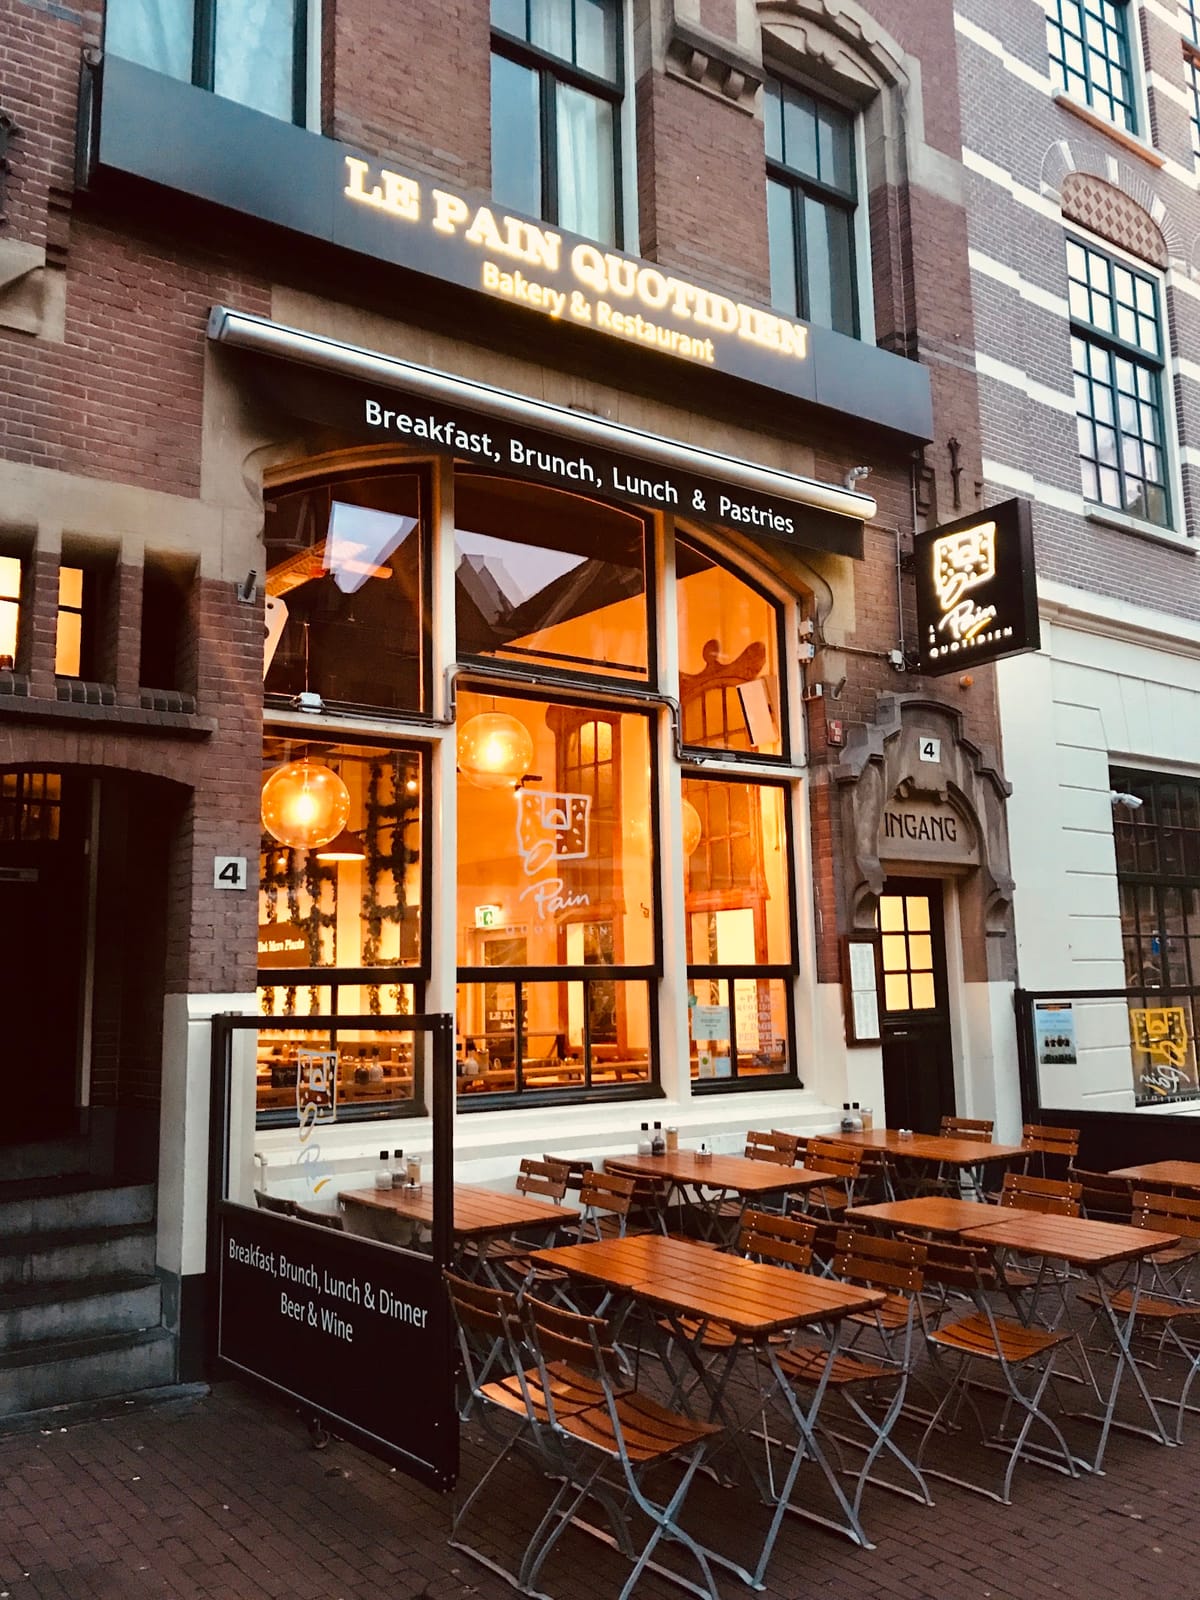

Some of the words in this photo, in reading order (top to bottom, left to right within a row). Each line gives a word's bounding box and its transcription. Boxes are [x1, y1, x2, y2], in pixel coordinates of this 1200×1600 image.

[345, 157, 419, 219] LE
[433, 190, 561, 270] PAIN
[572, 244, 807, 357] QUOTIDIEN
[483, 262, 567, 316] Bakery
[569, 289, 592, 324] &
[598, 304, 714, 363] Restaurant
[365, 399, 502, 464] Breakfast,
[509, 439, 604, 490] Brunch,
[612, 466, 679, 505] Lunch
[691, 488, 707, 512] &
[719, 495, 795, 535] Pastries
[929, 626, 1013, 658] QUOTIDIEN
[923, 742, 935, 758] 4
[884, 812, 957, 842] INGANG
[219, 862, 241, 884] 4
[519, 878, 590, 919] Pain
[229, 1238, 277, 1278] Breakfast,
[279, 1255, 321, 1294] Brunch,
[324, 1270, 360, 1304] Lunch
[364, 1282, 375, 1310] &
[379, 1289, 428, 1328] Dinner
[280, 1292, 305, 1321] Beer
[307, 1301, 318, 1327] &
[321, 1307, 353, 1342] Wine
